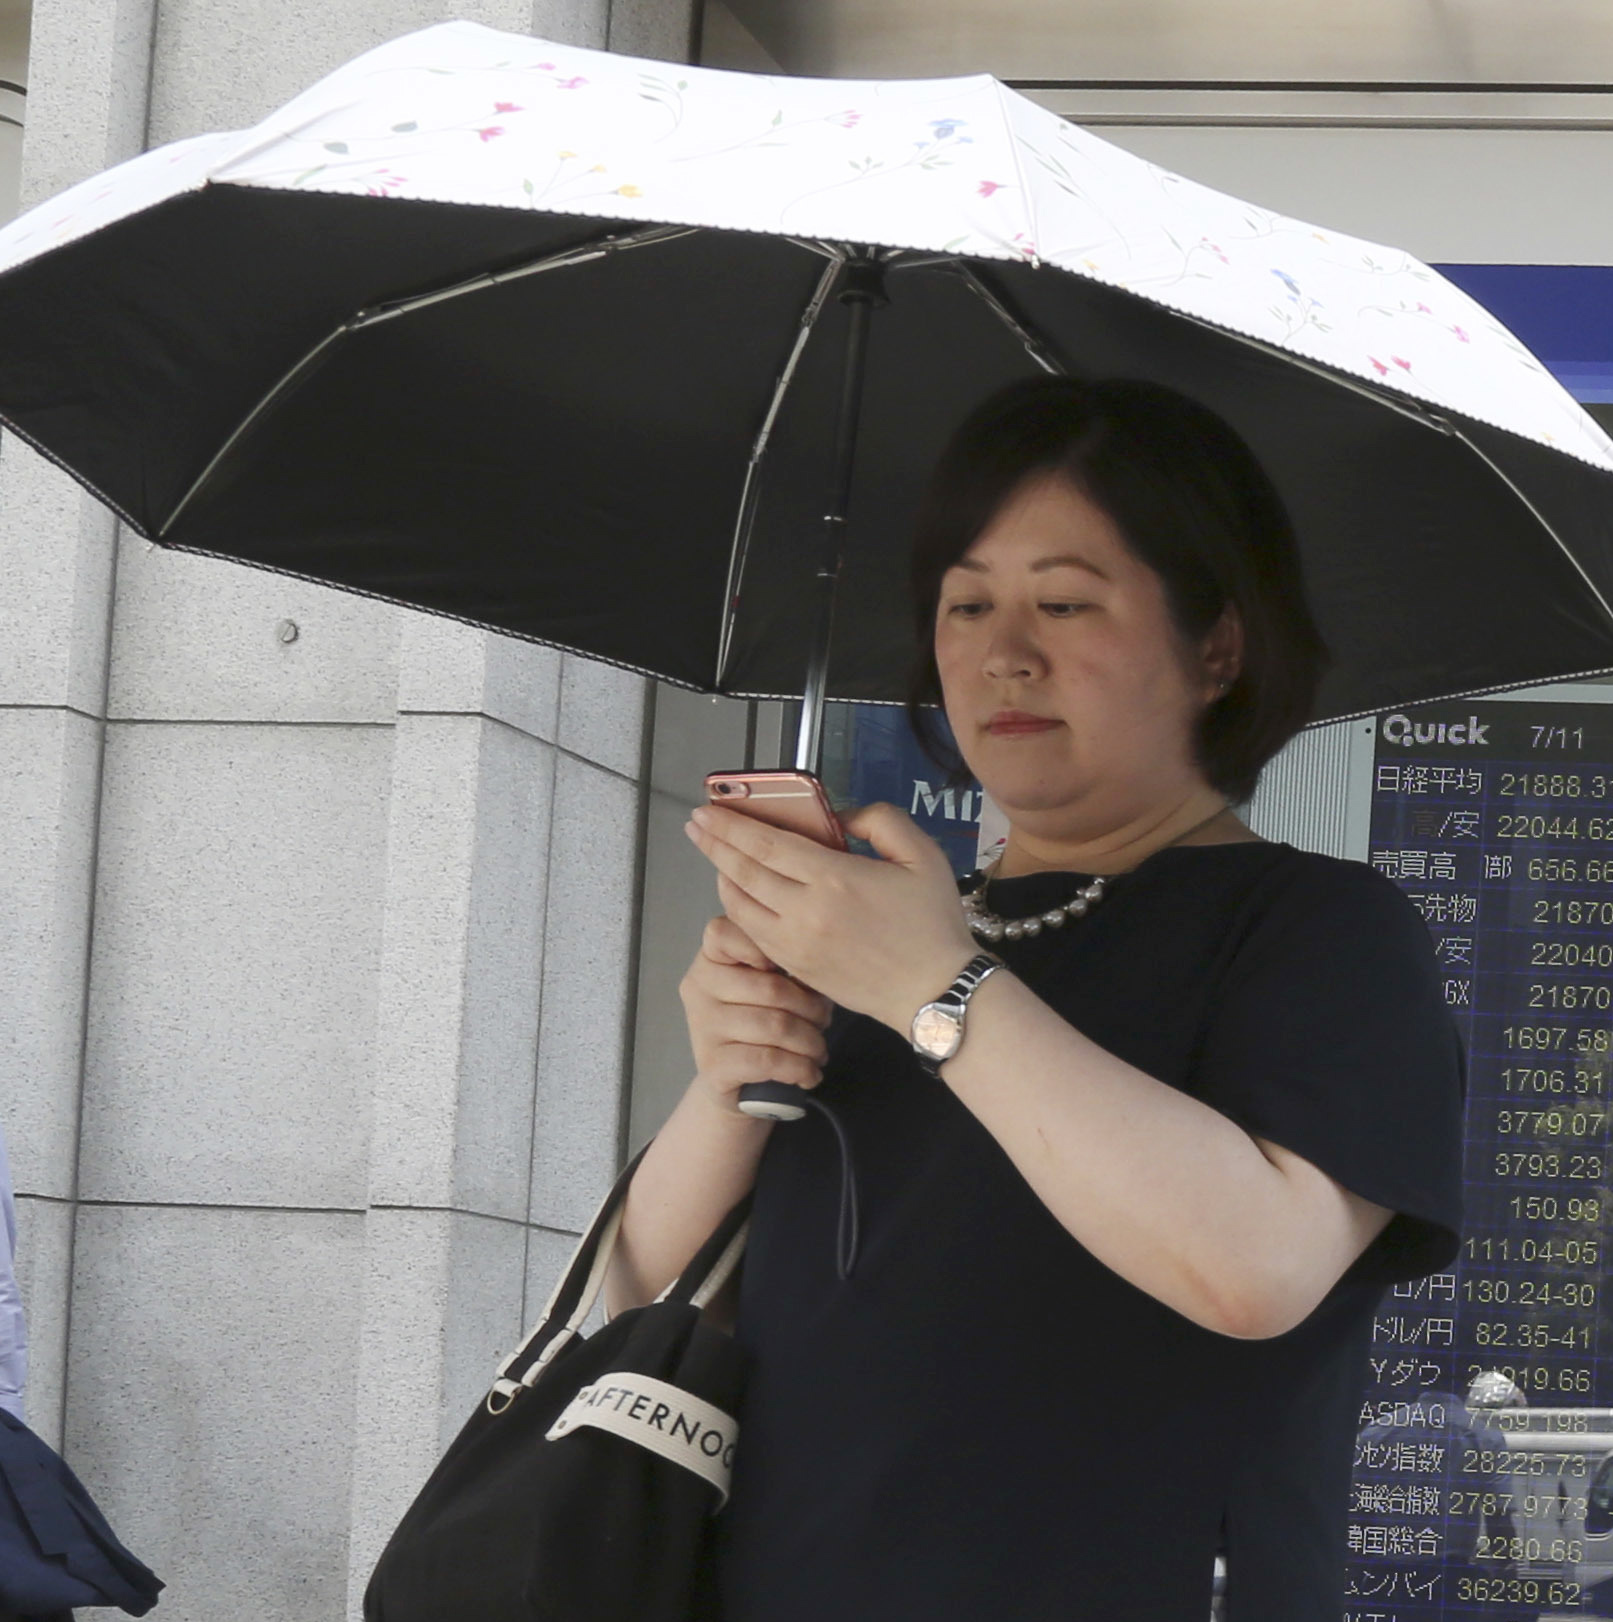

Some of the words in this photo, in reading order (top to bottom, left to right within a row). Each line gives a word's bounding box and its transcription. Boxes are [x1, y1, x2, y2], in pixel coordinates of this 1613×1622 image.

[1383, 714, 1491, 747] Quick
[1530, 725, 1585, 750] 7/11
[1377, 765, 1483, 795] 日経平均
[1372, 850, 1457, 880] 売買高
[1530, 943, 1613, 967] 22040
[1443, 980, 1470, 1005] GX
[1528, 985, 1612, 1010] 21870
[1503, 1027, 1609, 1052] 1697.58
[1501, 1068, 1604, 1094] 1706.31
[1498, 1110, 1605, 1136] 3779.07
[1495, 1153, 1601, 1179] 3793.23
[1510, 1196, 1600, 1222] 150.93
[1465, 1237, 1598, 1264] 111.04-05
[1463, 1279, 1595, 1307] 130.24-30
[1476, 1322, 1591, 1350] 82.35-41
[1467, 1364, 1591, 1393] 2919.66
[1358, 1400, 1446, 1429] ASDAQ
[1463, 1450, 1586, 1478] 28225.73
[1449, 1492, 1589, 1521] 2787.9773
[1475, 1535, 1583, 1563] 2280.66
[1457, 1577, 1580, 1605] 36239.62
